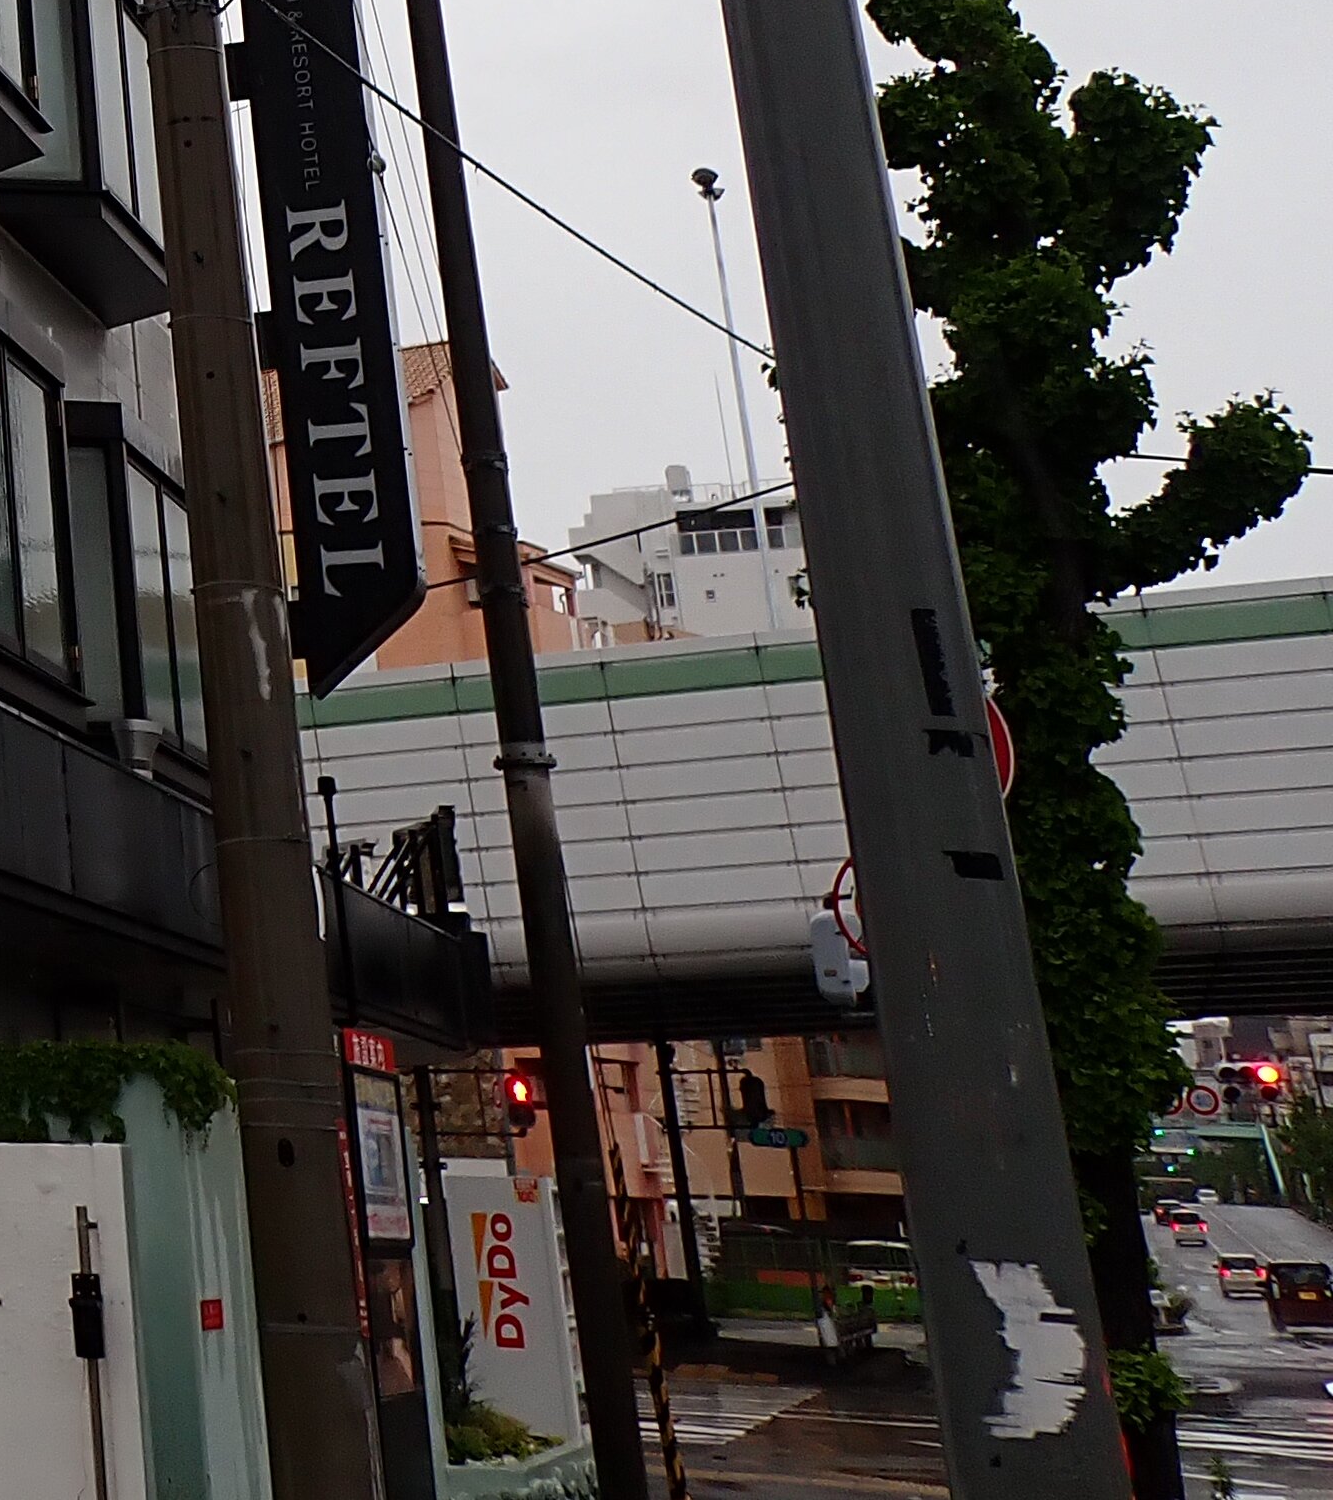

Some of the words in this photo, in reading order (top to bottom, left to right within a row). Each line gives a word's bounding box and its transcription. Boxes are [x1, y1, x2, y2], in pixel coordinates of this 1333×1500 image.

[290, 28, 315, 111] RESORT
[299, 122, 321, 191] HOTEL
[285, 198, 385, 598] REFTEL
